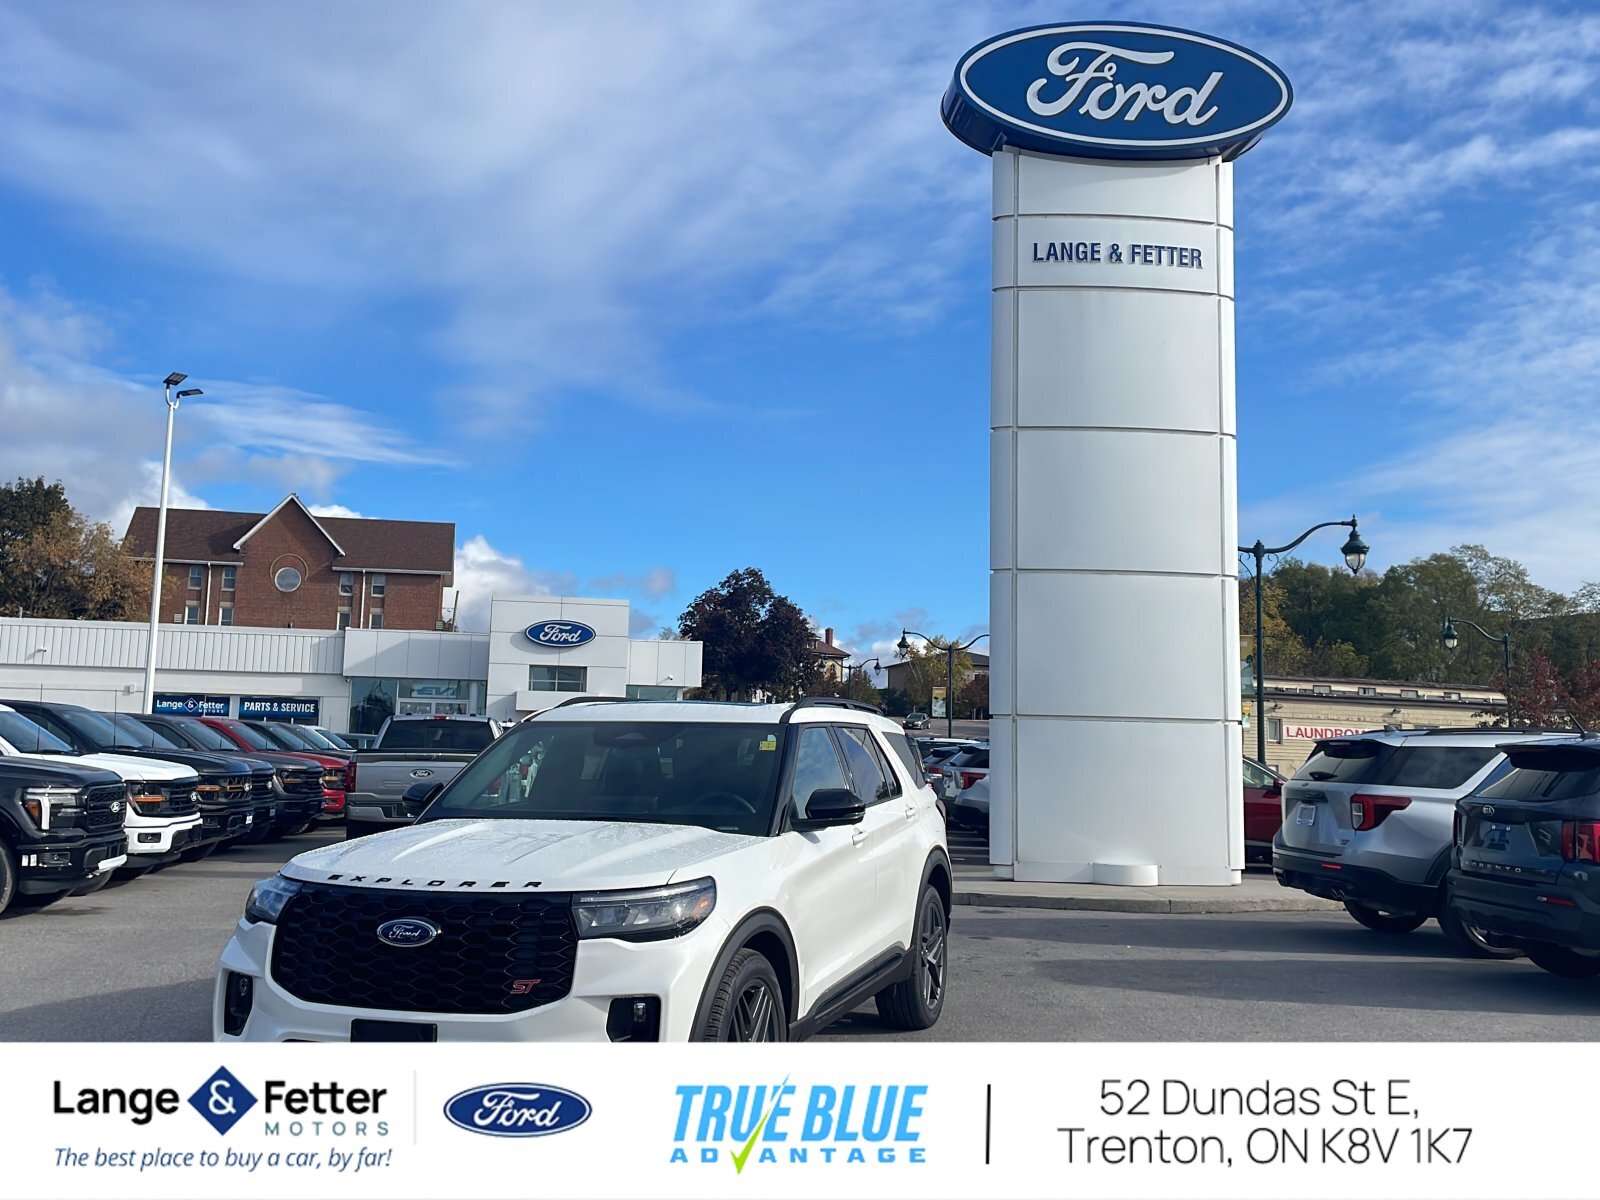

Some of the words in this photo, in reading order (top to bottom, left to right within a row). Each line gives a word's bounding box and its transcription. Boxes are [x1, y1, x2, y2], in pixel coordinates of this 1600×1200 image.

[1026, 41, 1223, 126] Ford
[1033, 242, 1101, 263] LANGE
[1109, 243, 1123, 263] &
[1130, 244, 1203, 269] FETTER
[540, 624, 581, 642] Ford
[156, 700, 183, 710] Lange
[198, 700, 225, 710] Fetter
[243, 702, 271, 712] PARTS
[272, 703, 279, 712] &
[281, 702, 315, 713] SERVICE
[327, 874, 542, 888] EXPLORER
[388, 924, 421, 939] Ford
[510, 979, 541, 994] ST
